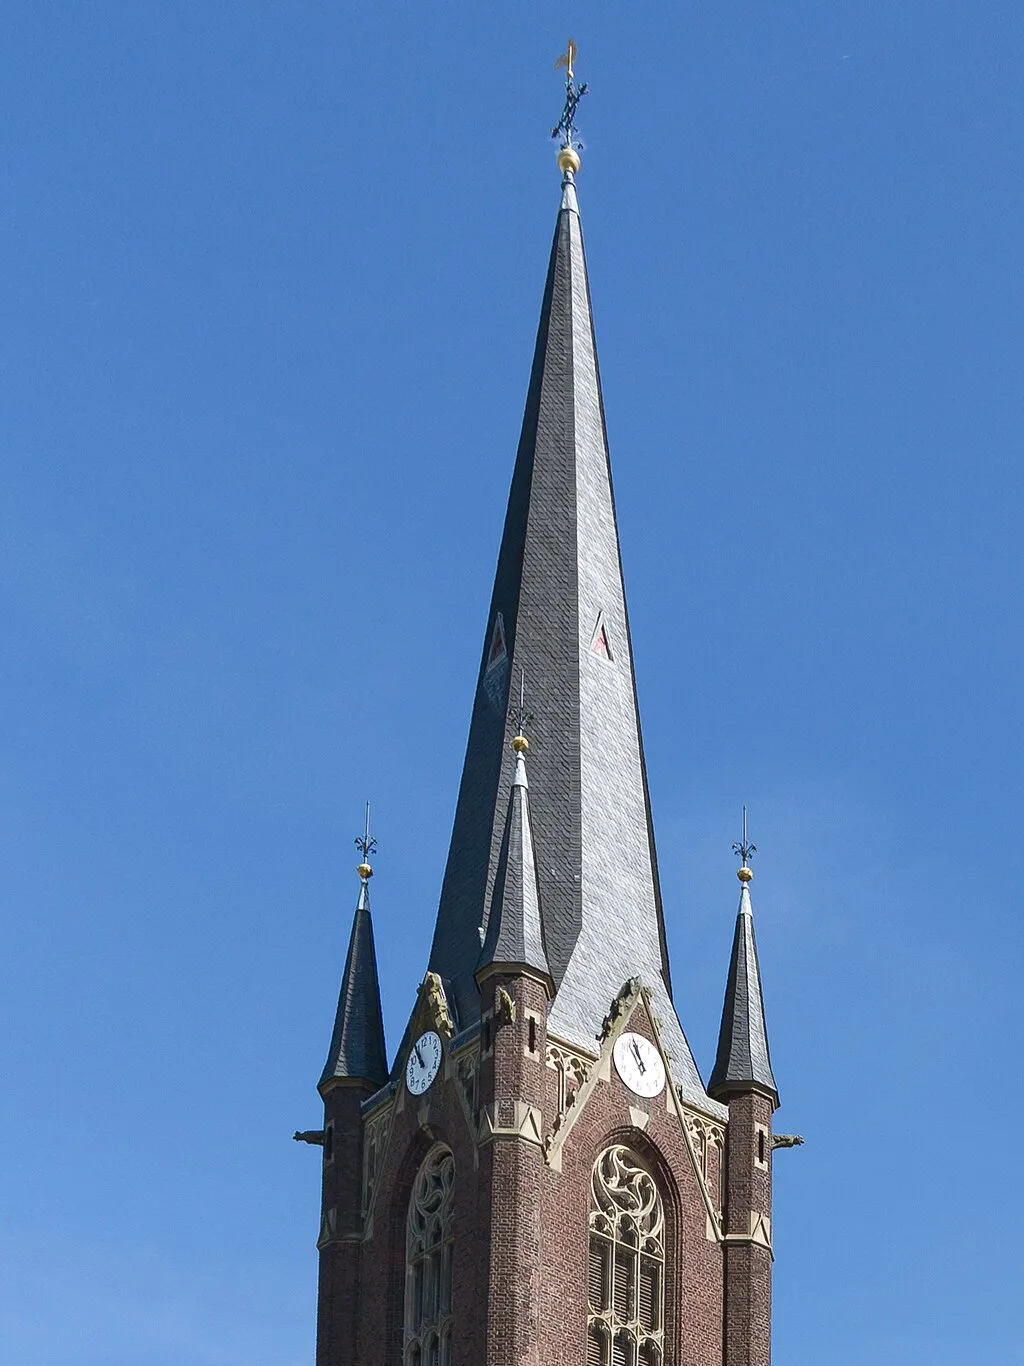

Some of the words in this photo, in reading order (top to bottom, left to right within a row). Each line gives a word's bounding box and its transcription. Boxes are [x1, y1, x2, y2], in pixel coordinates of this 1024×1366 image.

[421, 1037, 427, 1048] 12
[410, 1055, 417, 1066] 10
[433, 1060, 437, 1069] 4
[409, 1067, 414, 1077] 9
[428, 1071, 433, 1082] 5
[410, 1077, 415, 1087] 8
[415, 1079, 420, 1090] 7
[421, 1079, 426, 1089] 6
